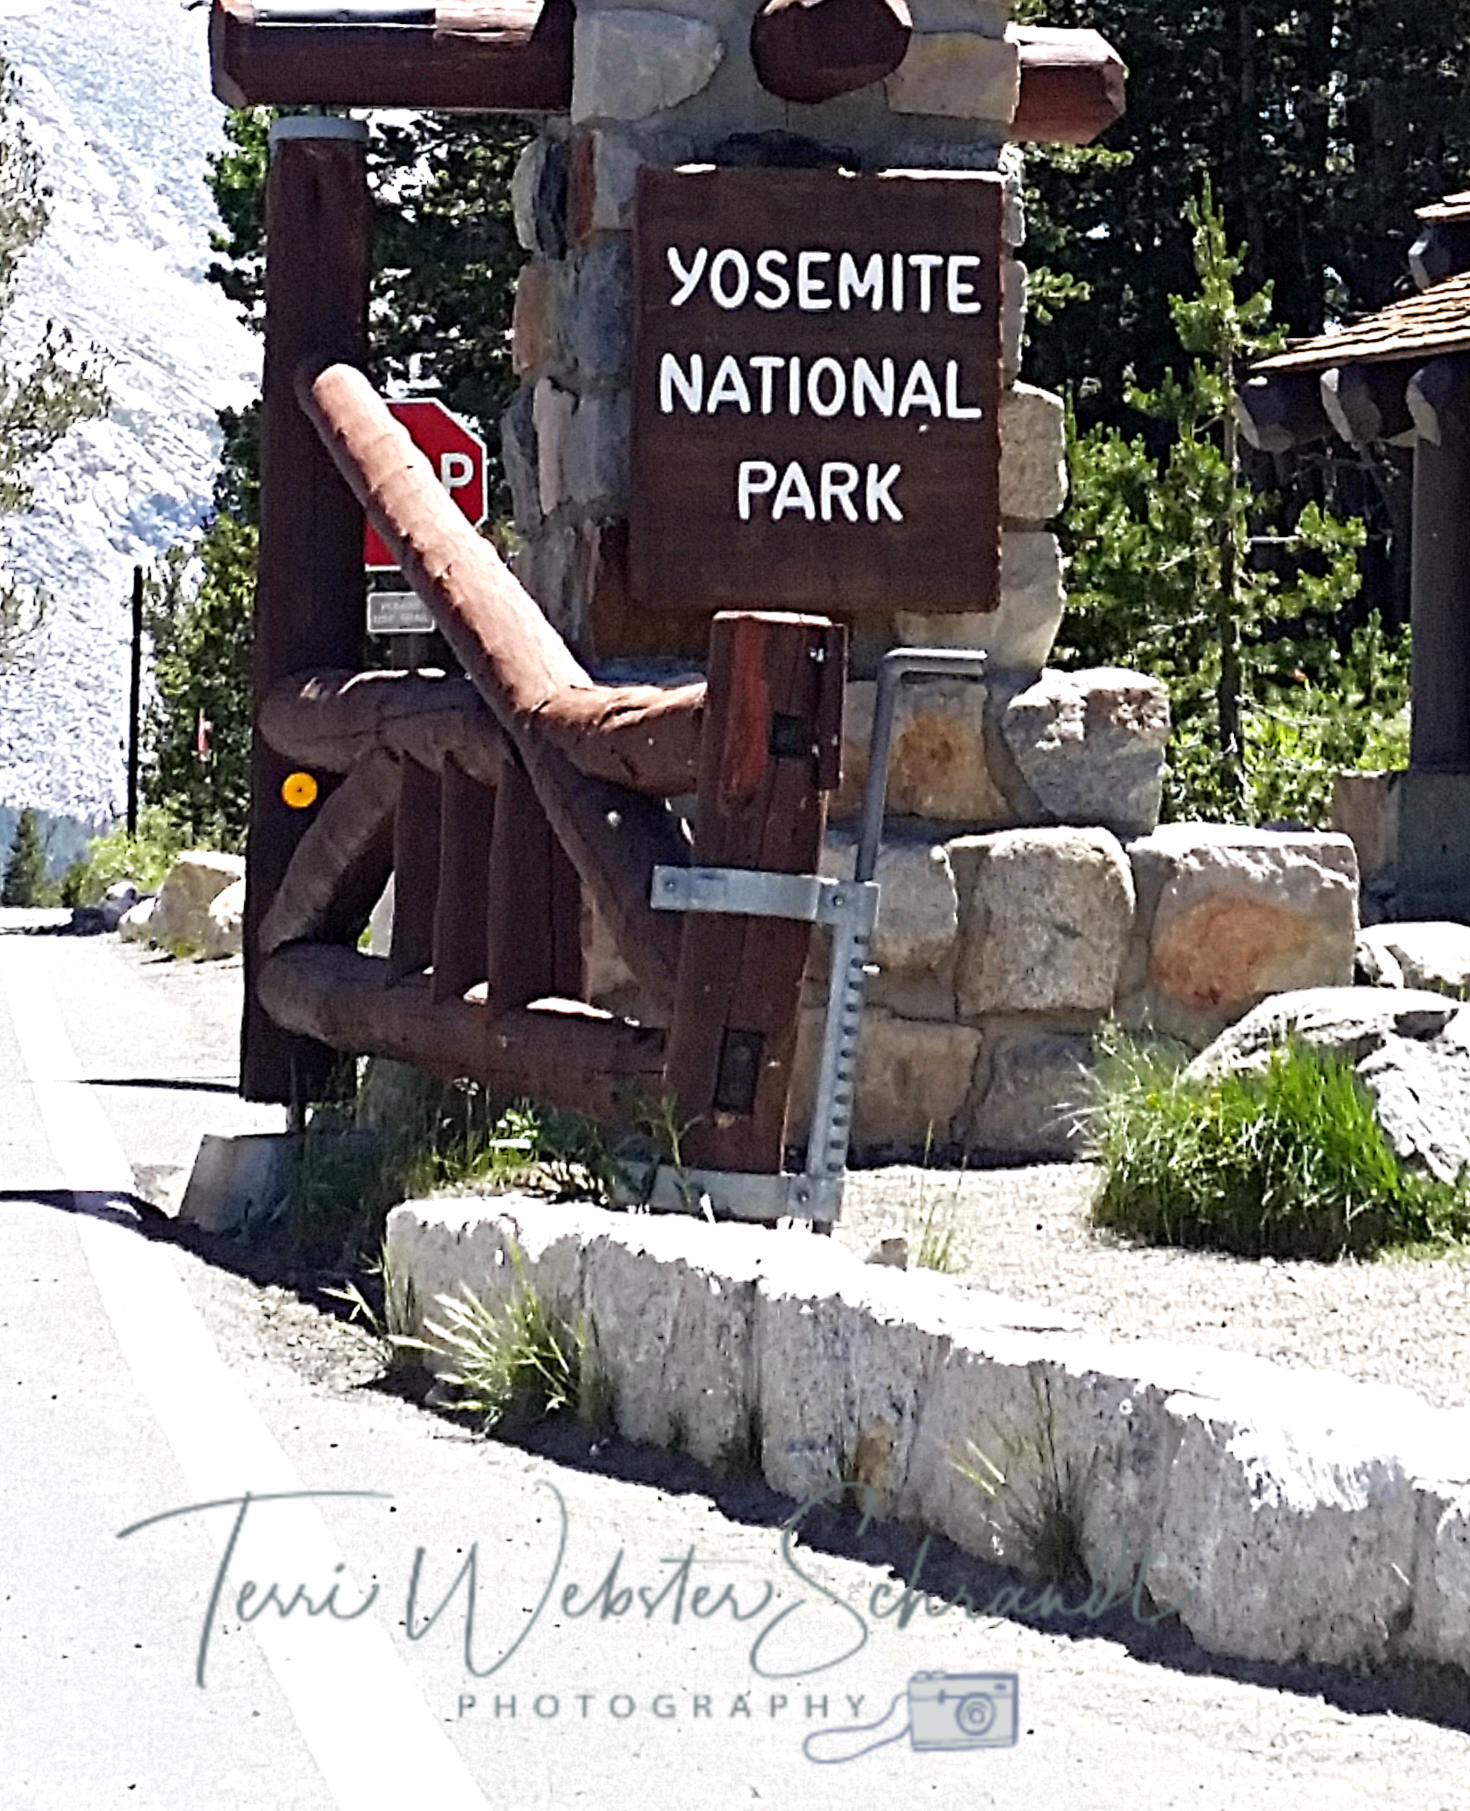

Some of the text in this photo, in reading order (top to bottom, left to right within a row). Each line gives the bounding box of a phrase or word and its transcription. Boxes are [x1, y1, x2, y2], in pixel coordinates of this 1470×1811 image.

[666, 246, 982, 314] YOSEMITE
[659, 353, 982, 419] NATIONAL
[738, 460, 904, 522] PARK
